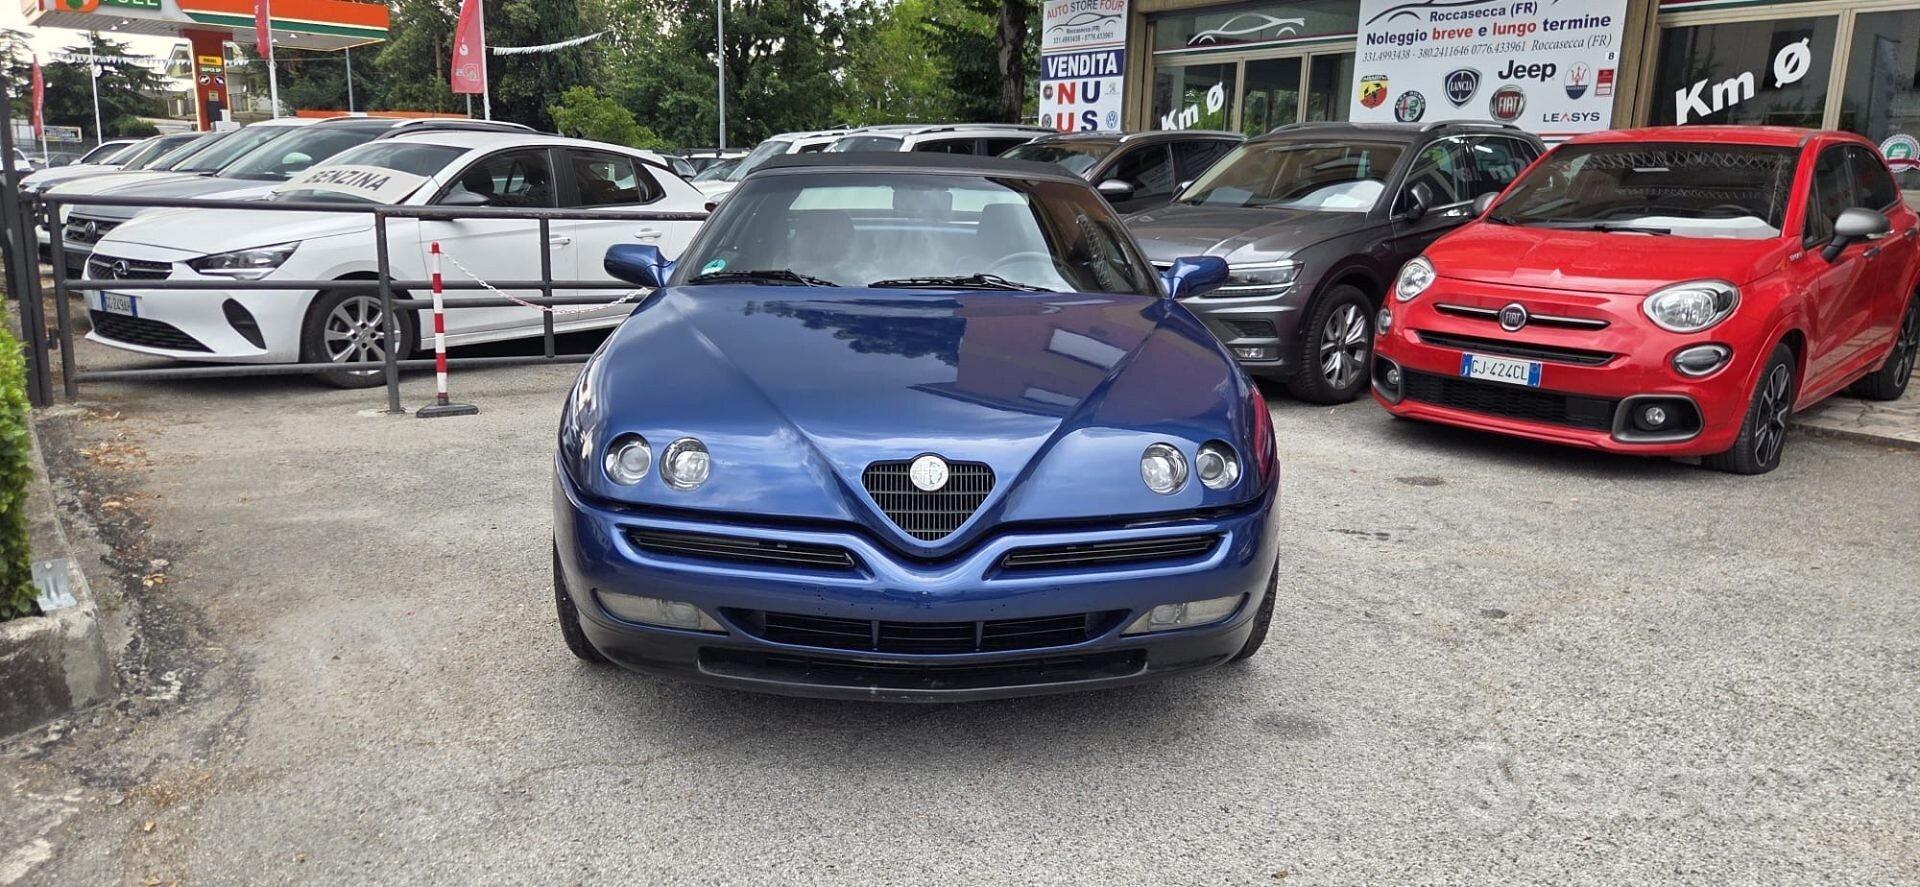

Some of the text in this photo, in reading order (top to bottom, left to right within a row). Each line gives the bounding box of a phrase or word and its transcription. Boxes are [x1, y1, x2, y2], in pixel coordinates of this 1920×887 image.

[1047, 0, 1124, 20] AUTO STORE FOUR
[1430, 1, 1538, 22] Roccasecca (FR)
[1366, 14, 1612, 46] Noleggio breve e lungo termine
[1363, 49, 1411, 62] 331.4993438
[1418, 44, 1470, 59] 380.2411646
[1471, 41, 1526, 56] 0776.433961
[1531, 38, 1585, 52] Roccasecca
[1587, 33, 1612, 49] (FR)
[1608, 52, 1615, 60] 8
[1047, 52, 1118, 78] VENDITA
[1498, 60, 1557, 82] Jeep
[1450, 81, 1473, 92] LANCIA
[1498, 96, 1519, 112] FIAT
[1675, 71, 1755, 126] Km
[1161, 104, 1199, 131] Km
[1543, 112, 1600, 122] LEASYS
[304, 170, 390, 192] BENZINA
[1505, 311, 1521, 325] FIAT
